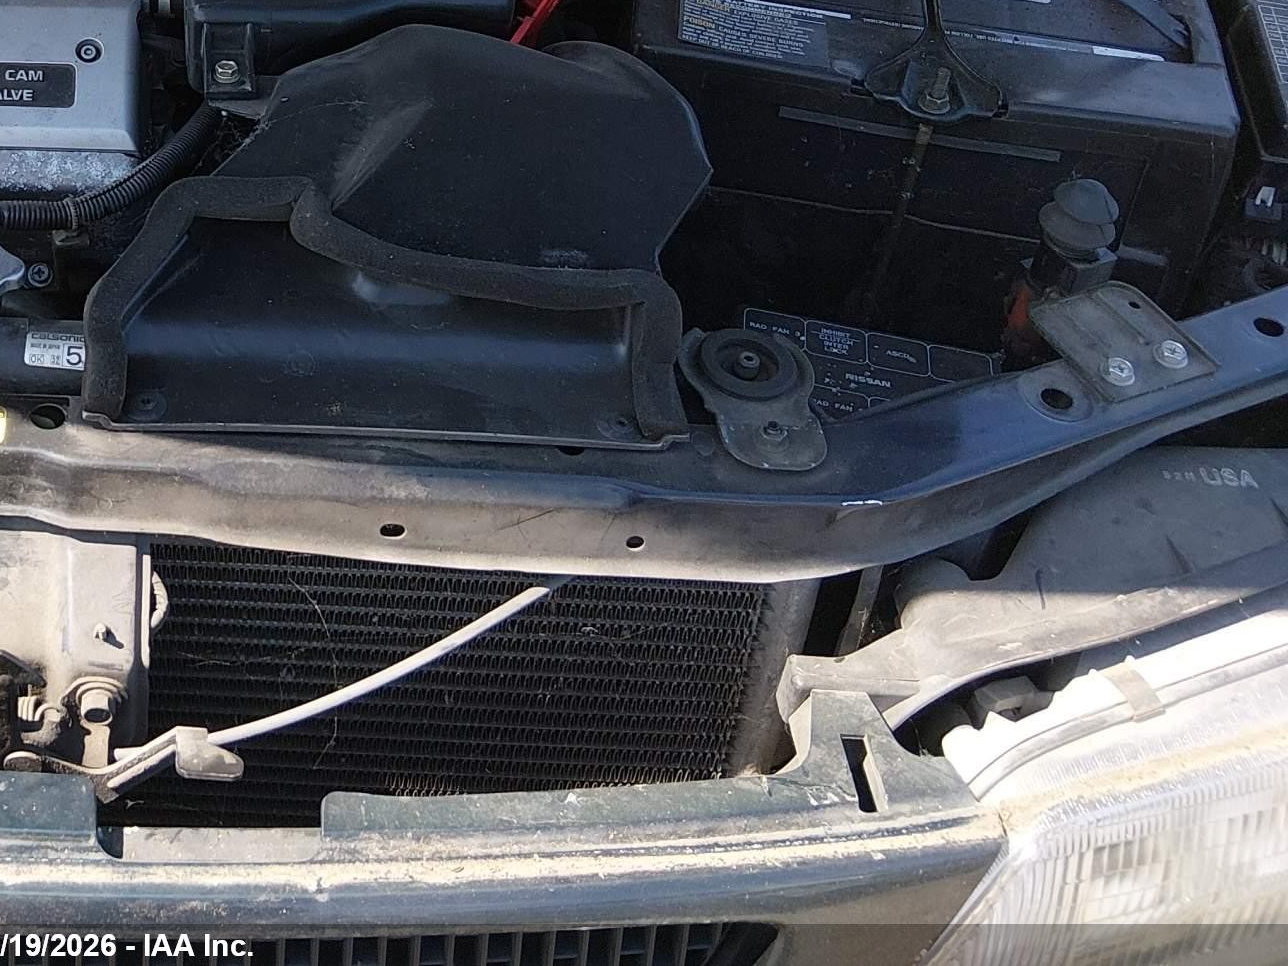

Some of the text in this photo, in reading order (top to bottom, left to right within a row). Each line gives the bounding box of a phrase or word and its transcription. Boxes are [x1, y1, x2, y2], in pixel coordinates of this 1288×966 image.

[683, 15, 804, 48] POISON CAUSES SEVERE BURNS
[5, 69, 45, 83] CAM
[749, 321, 768, 330] RAD
[772, 326, 790, 335] FAN
[820, 328, 850, 338] INHIBIT
[818, 334, 854, 346] CLUTCH
[823, 340, 849, 350] INTER
[30, 354, 44, 364] OK
[66, 346, 83, 366] 5
[824, 346, 848, 356] LOCK
[845, 372, 891, 388] NISSAN
[1198, 467, 1260, 489] USA
